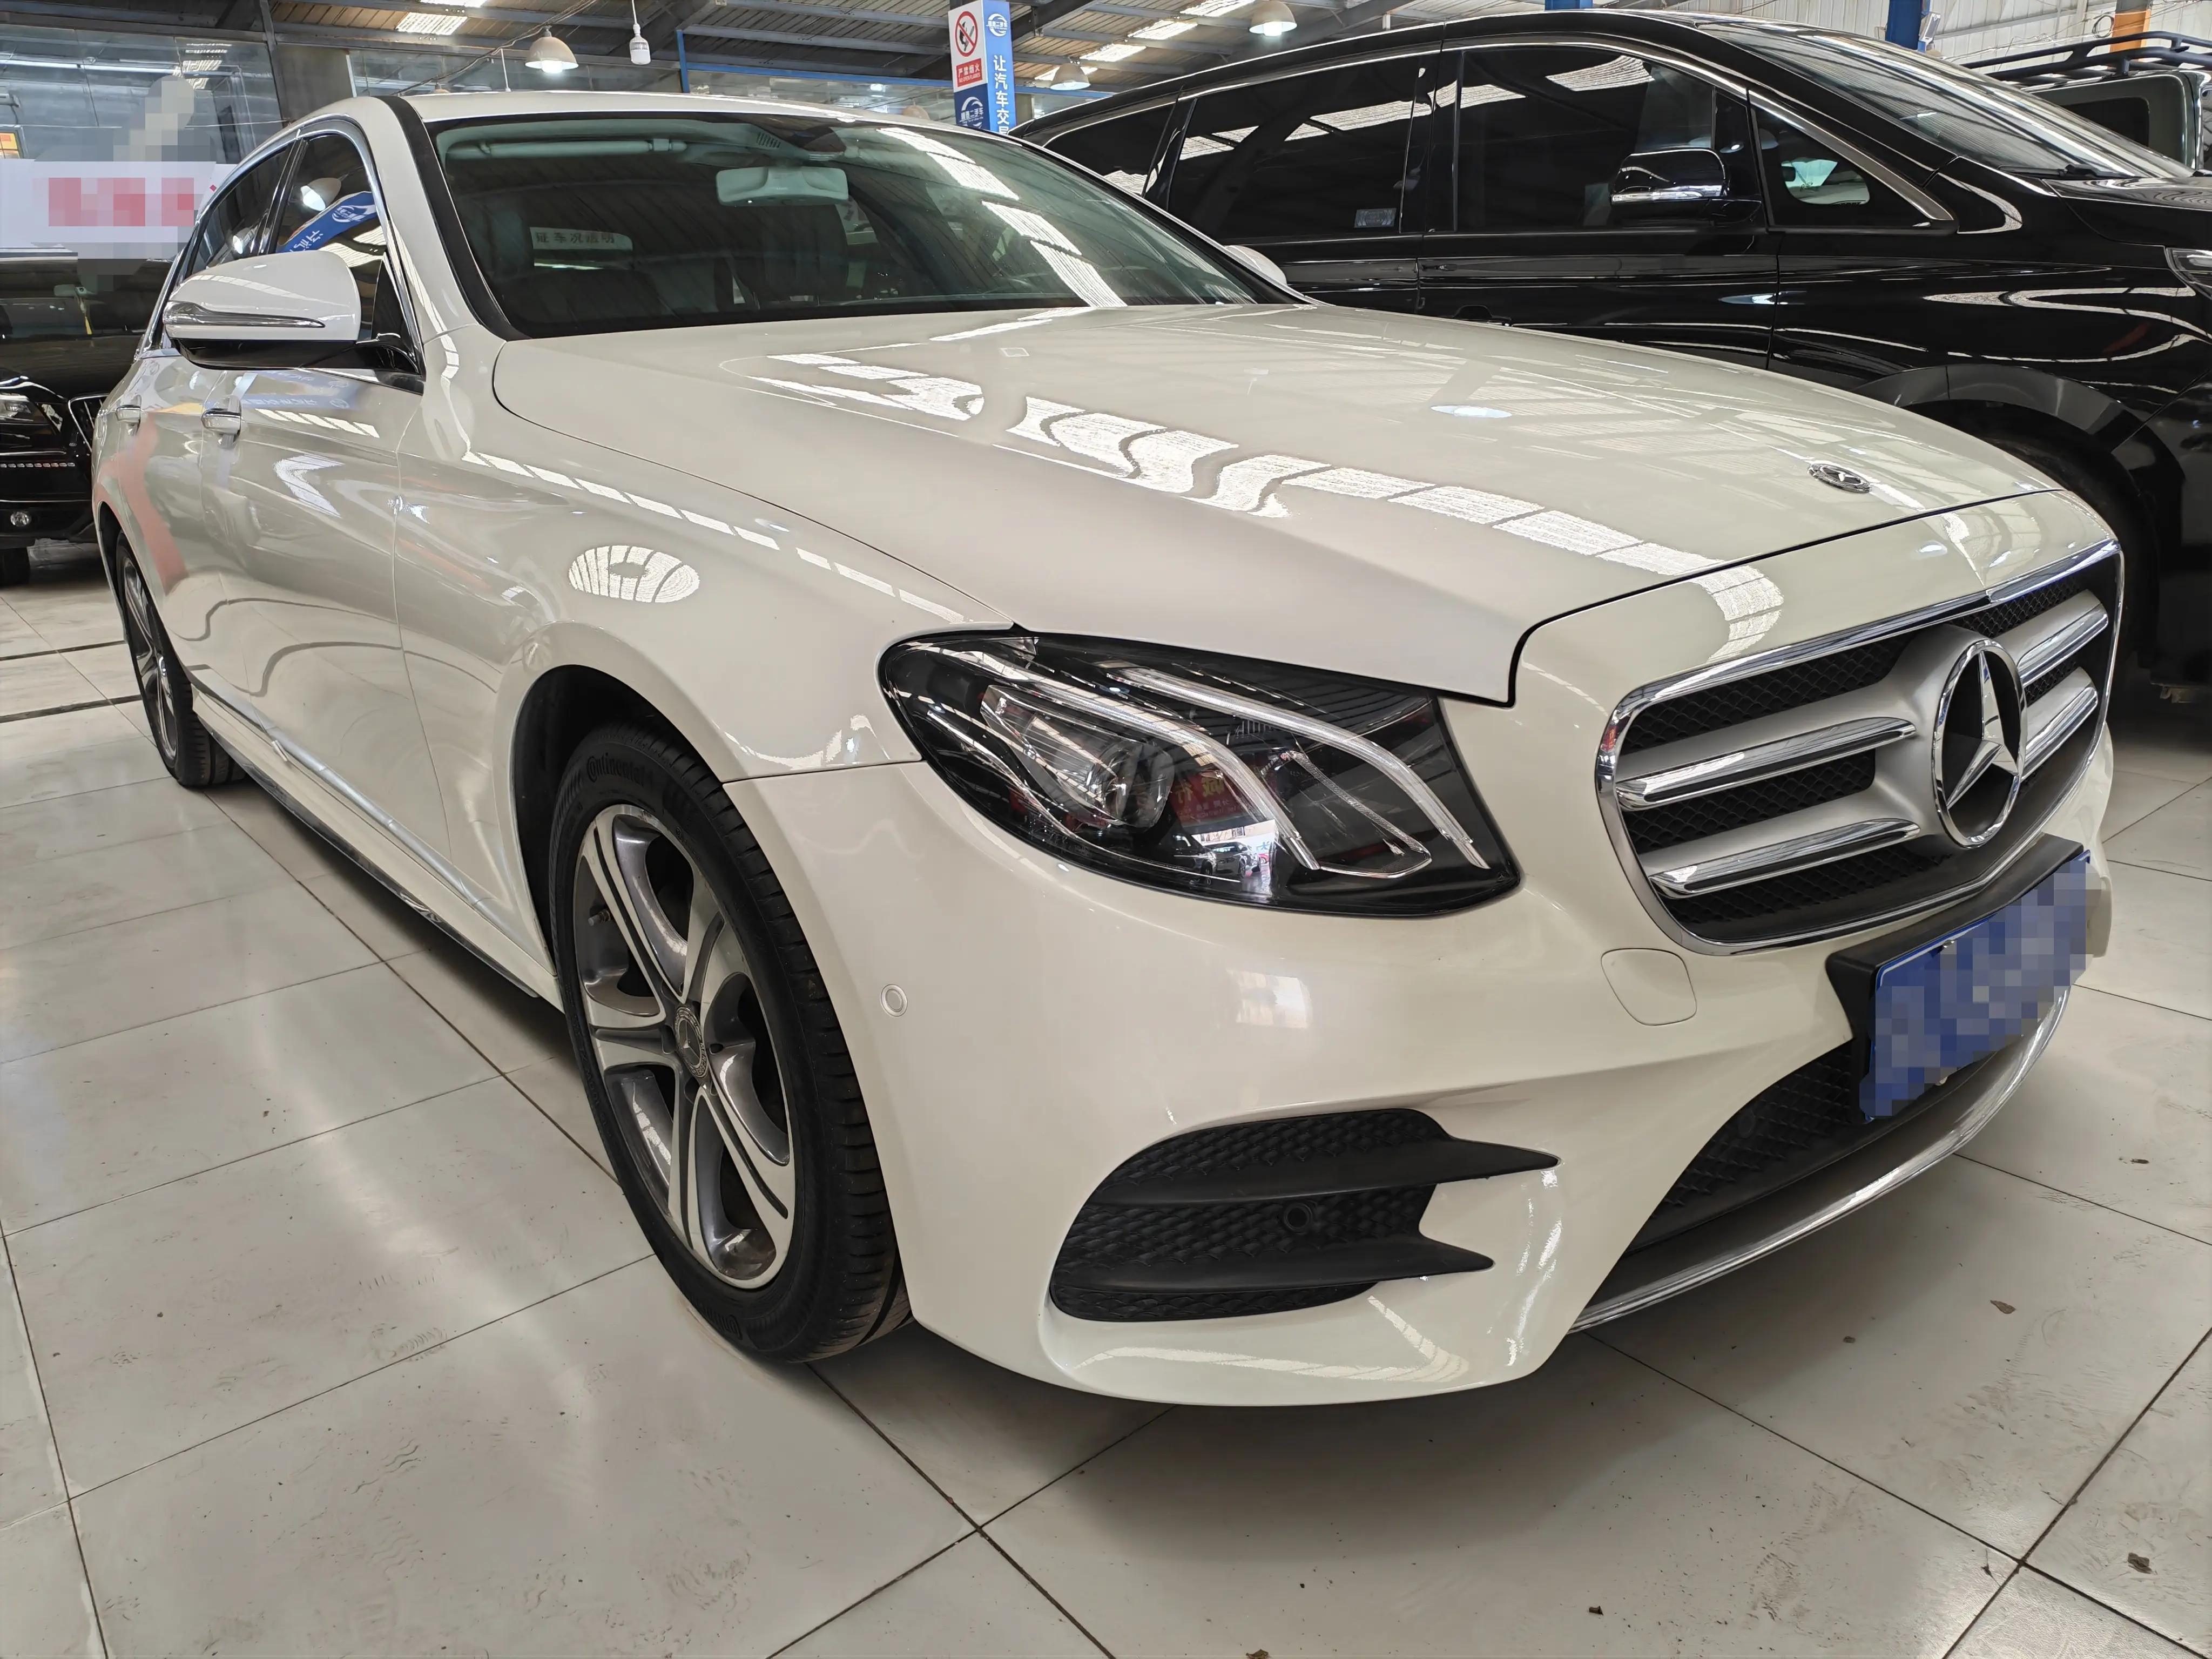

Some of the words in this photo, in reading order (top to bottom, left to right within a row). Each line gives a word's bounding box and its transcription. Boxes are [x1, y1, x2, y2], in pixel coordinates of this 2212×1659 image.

[958, 63, 980, 78] 严禁烟火
[586, 753, 645, 787] Continental
